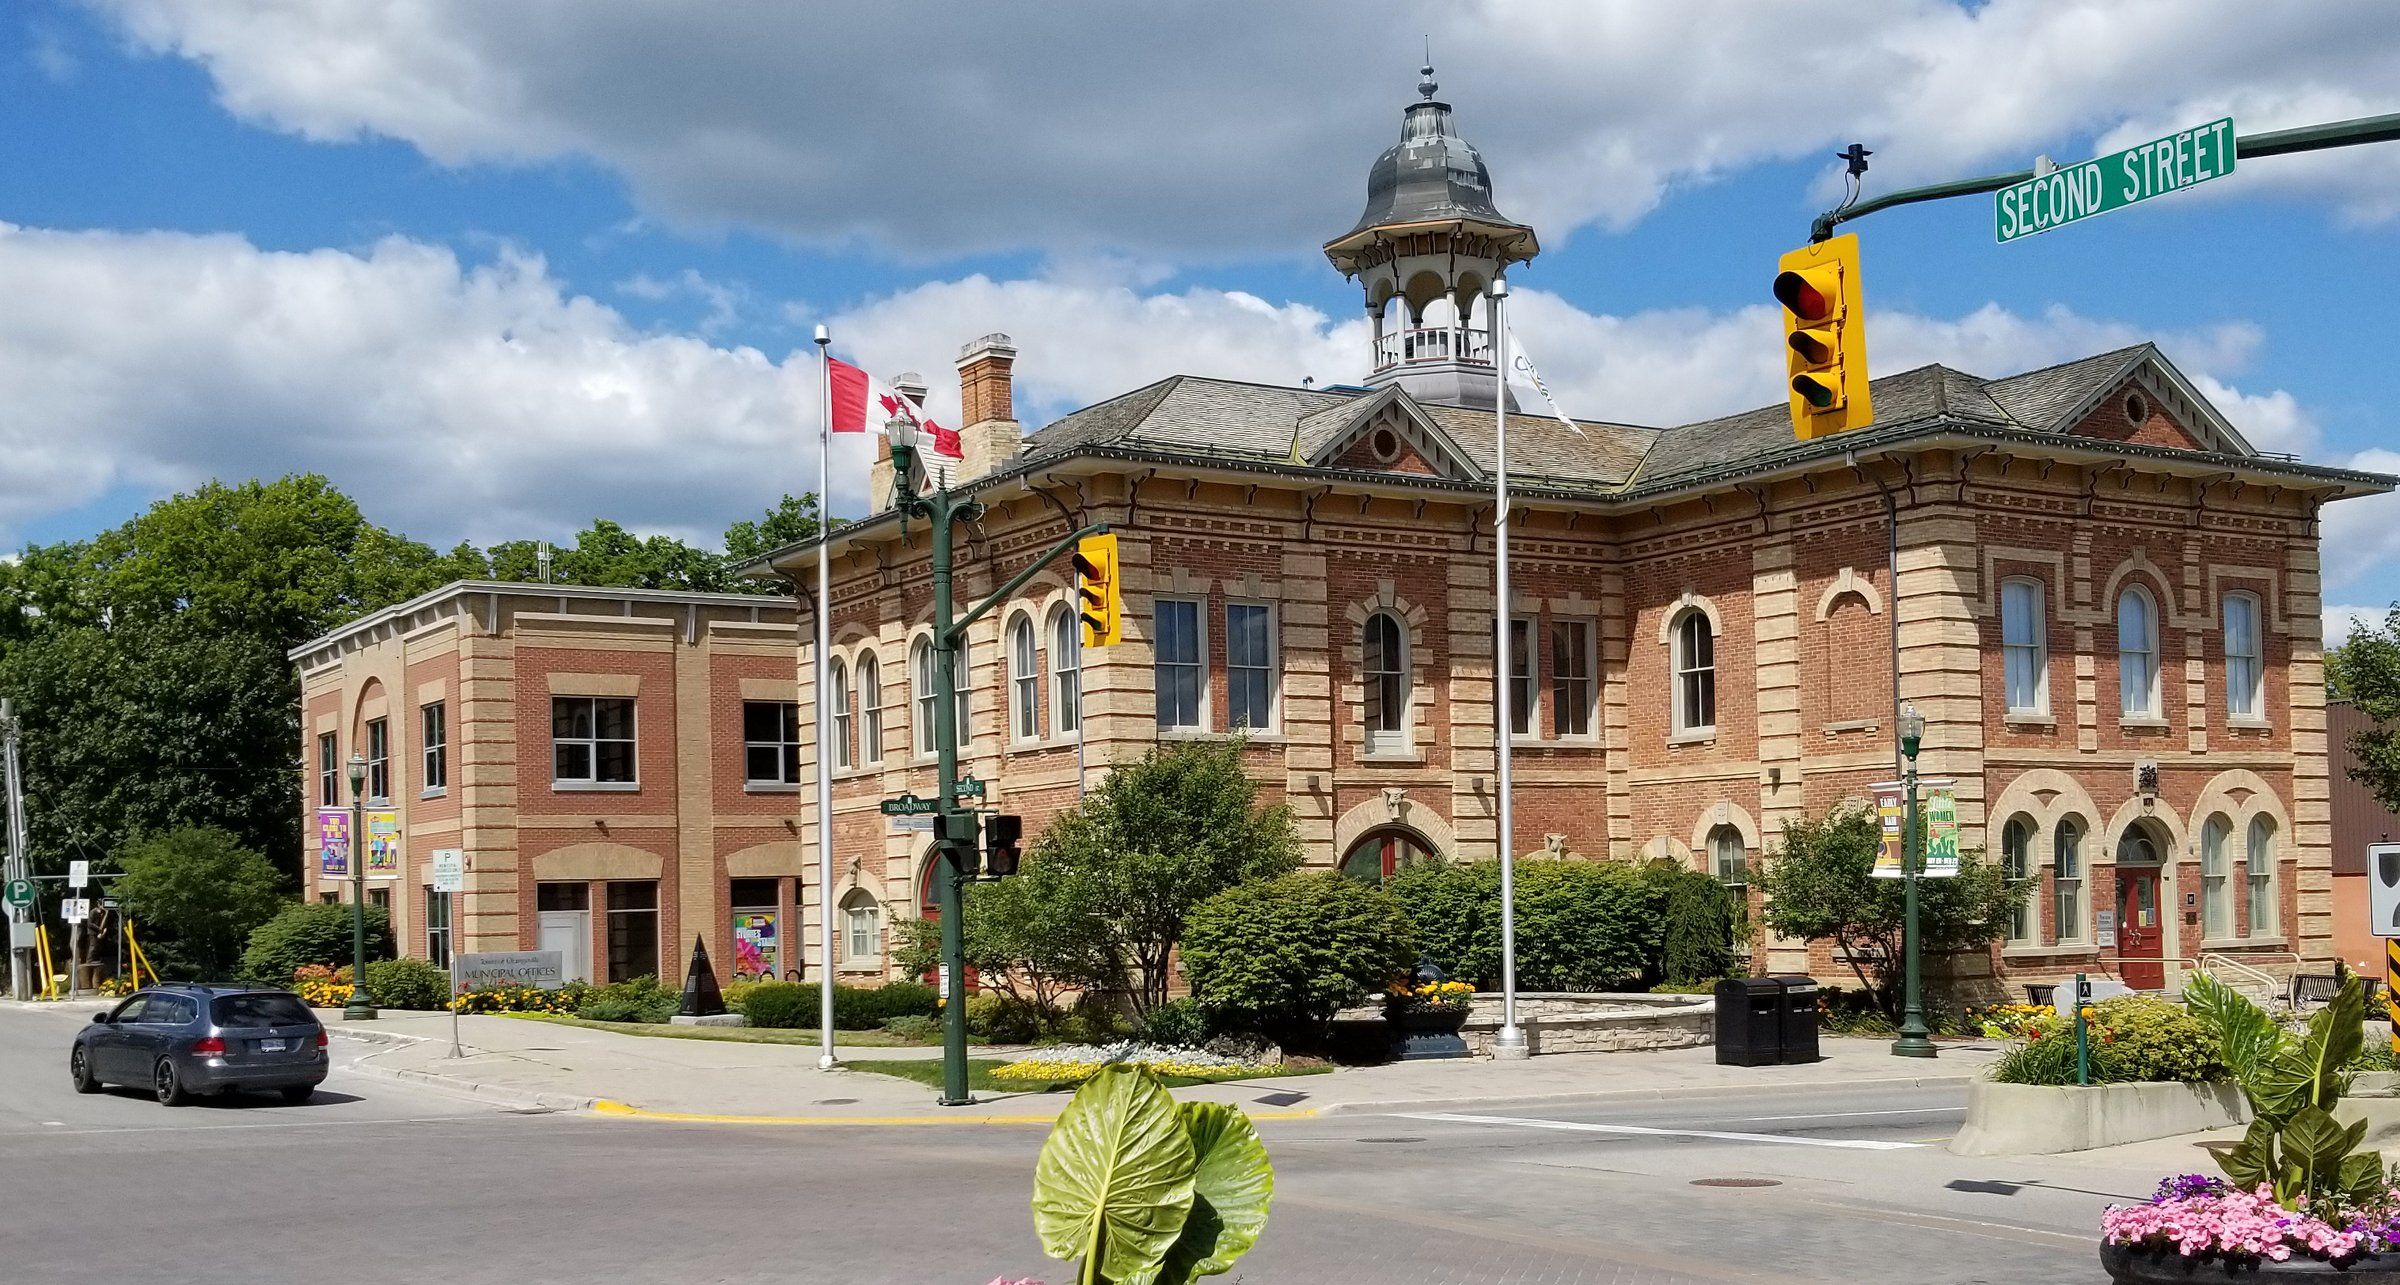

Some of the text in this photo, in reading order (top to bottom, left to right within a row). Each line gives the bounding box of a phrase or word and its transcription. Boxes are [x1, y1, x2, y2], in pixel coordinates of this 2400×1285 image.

[2001, 120, 2228, 239] SECOND STREET
[888, 803, 932, 812] BROADWAY
[444, 852, 451, 863] P
[13, 882, 28, 899] P
[464, 967, 556, 979] MUNICIPAL OFFICES
